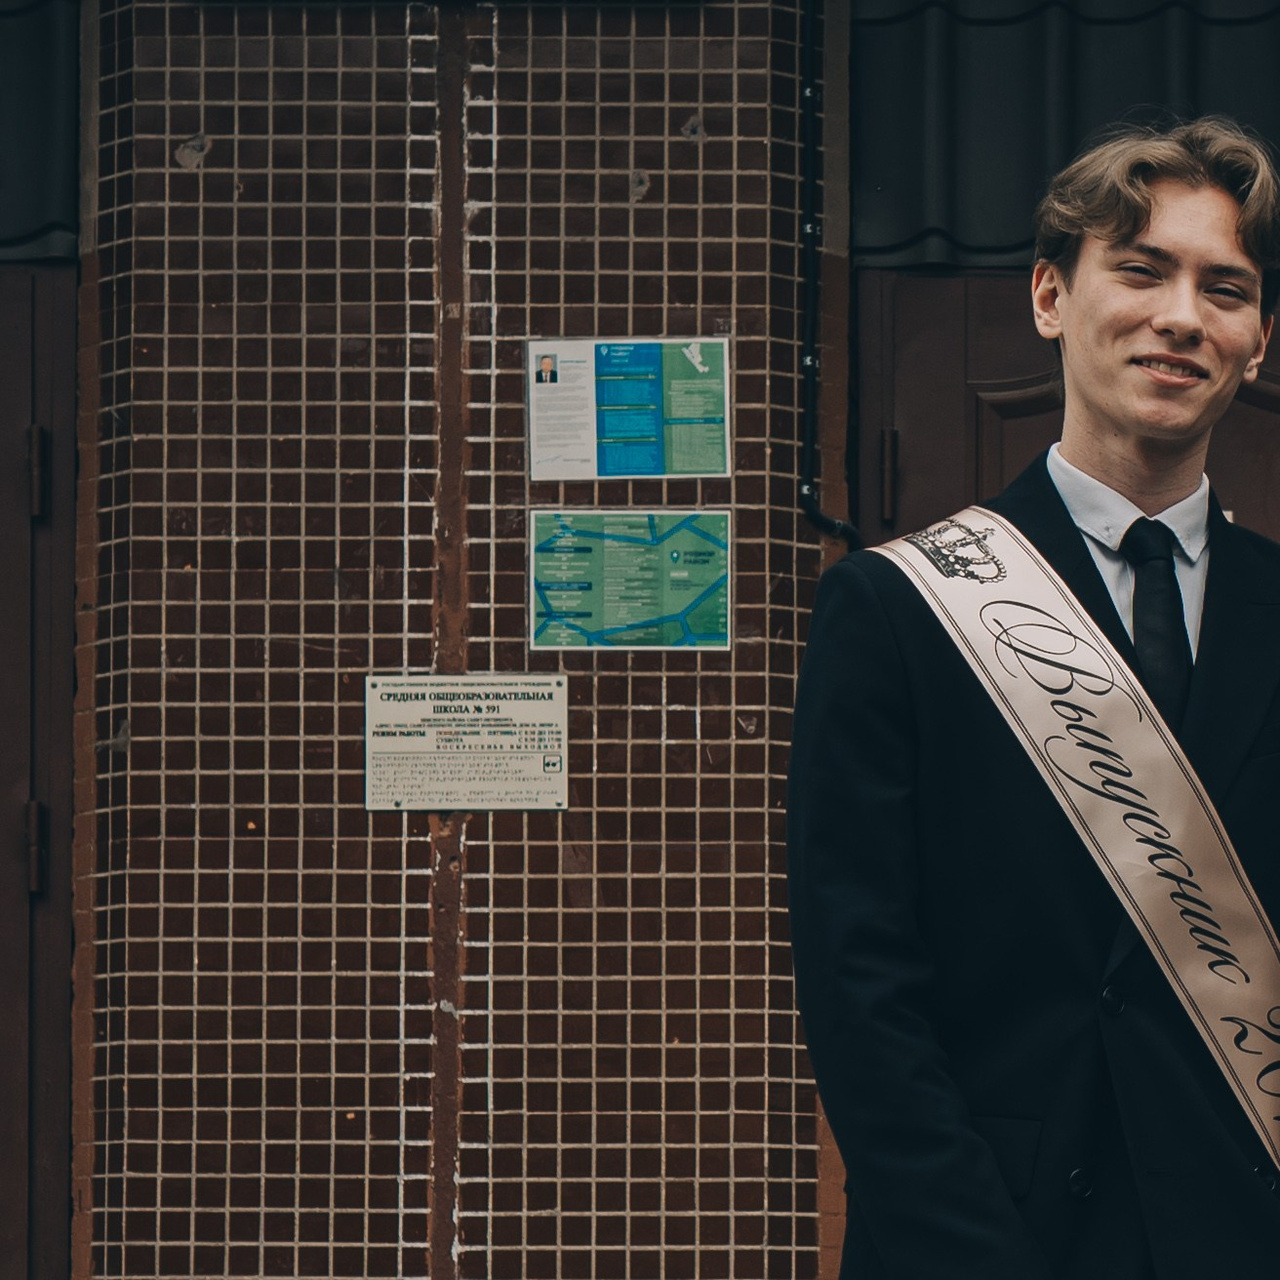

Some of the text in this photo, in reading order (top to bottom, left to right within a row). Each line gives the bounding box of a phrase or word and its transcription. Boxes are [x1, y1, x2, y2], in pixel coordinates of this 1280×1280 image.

[380, 692, 554, 702] СРЕДНЯЯ ОБЩЕОБРАЗОВАТЕЛЬНАЯ
[433, 705, 470, 714] ШКОЛА
[485, 705, 500, 714] 591
[978, 599, 1251, 986] Выпускник
